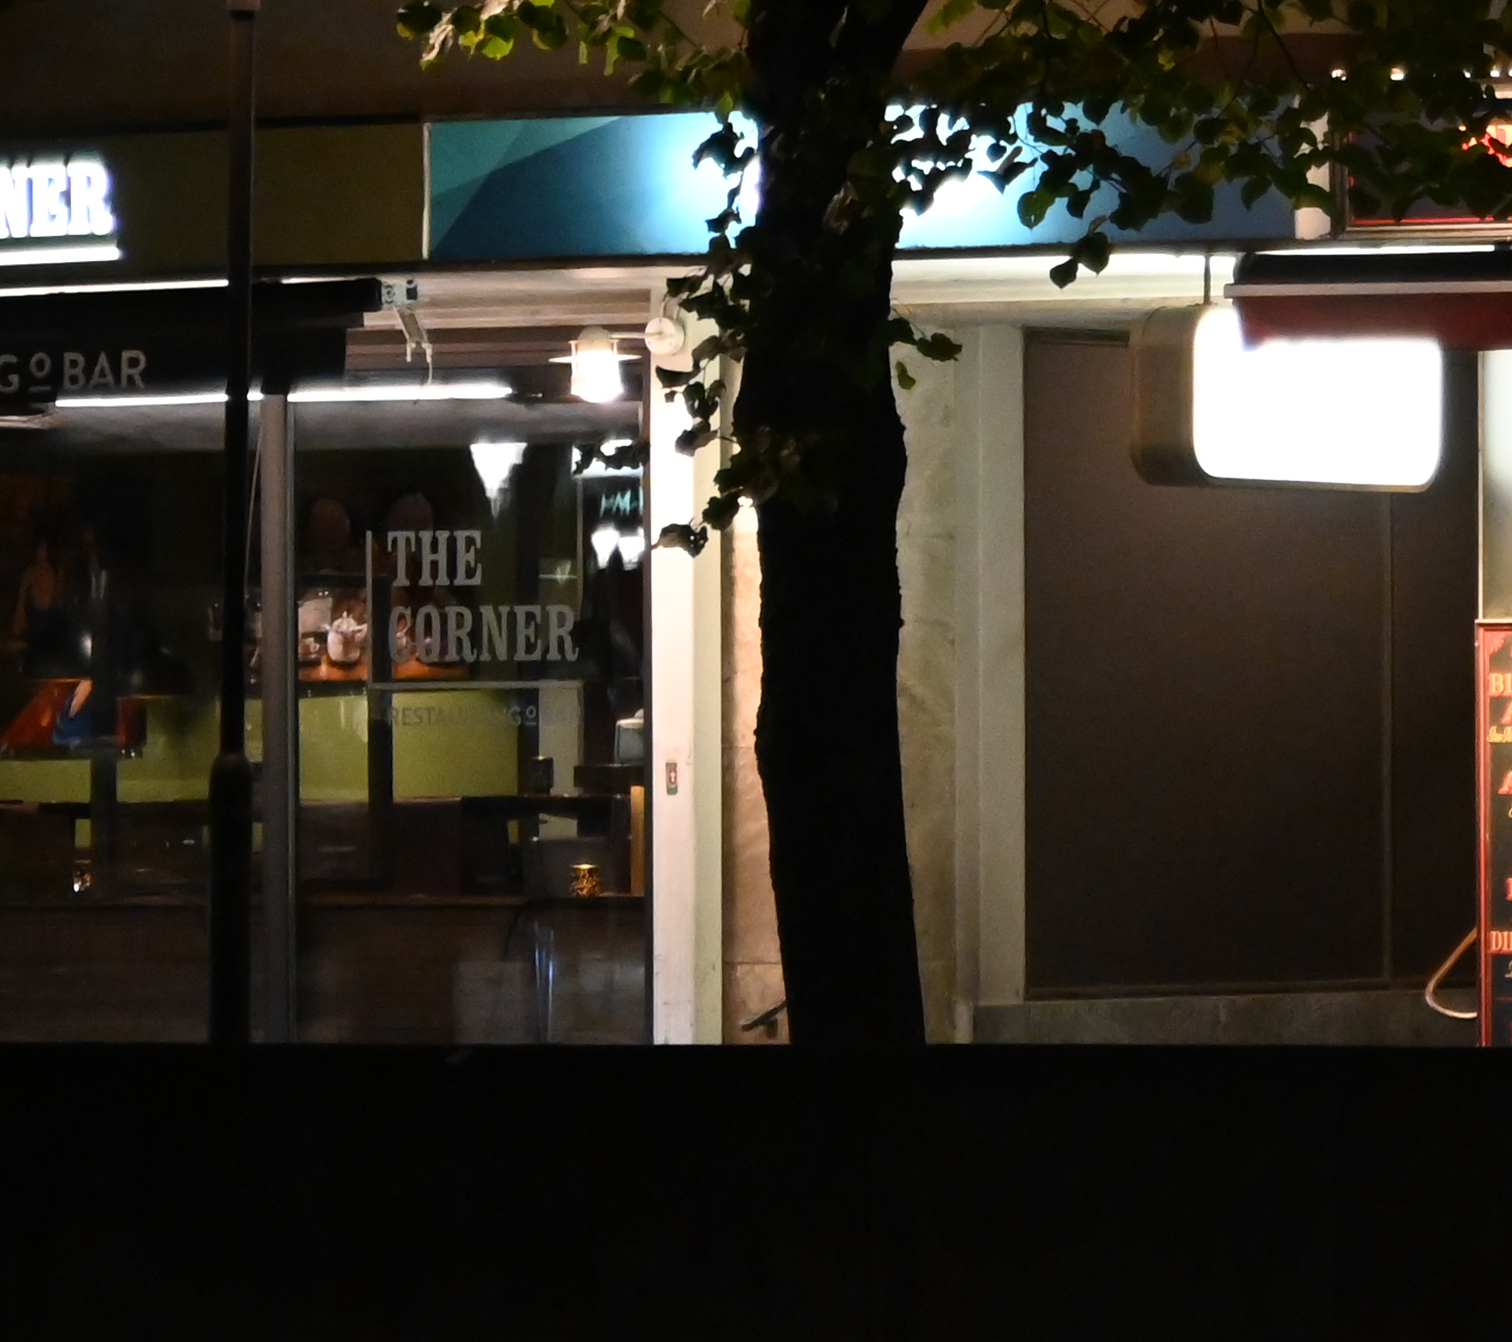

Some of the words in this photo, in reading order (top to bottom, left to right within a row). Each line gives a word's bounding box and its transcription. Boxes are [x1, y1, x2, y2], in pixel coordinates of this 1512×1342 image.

[62, 349, 148, 392] BAR
[387, 530, 483, 587] THE
[388, 604, 579, 664] CORNER
